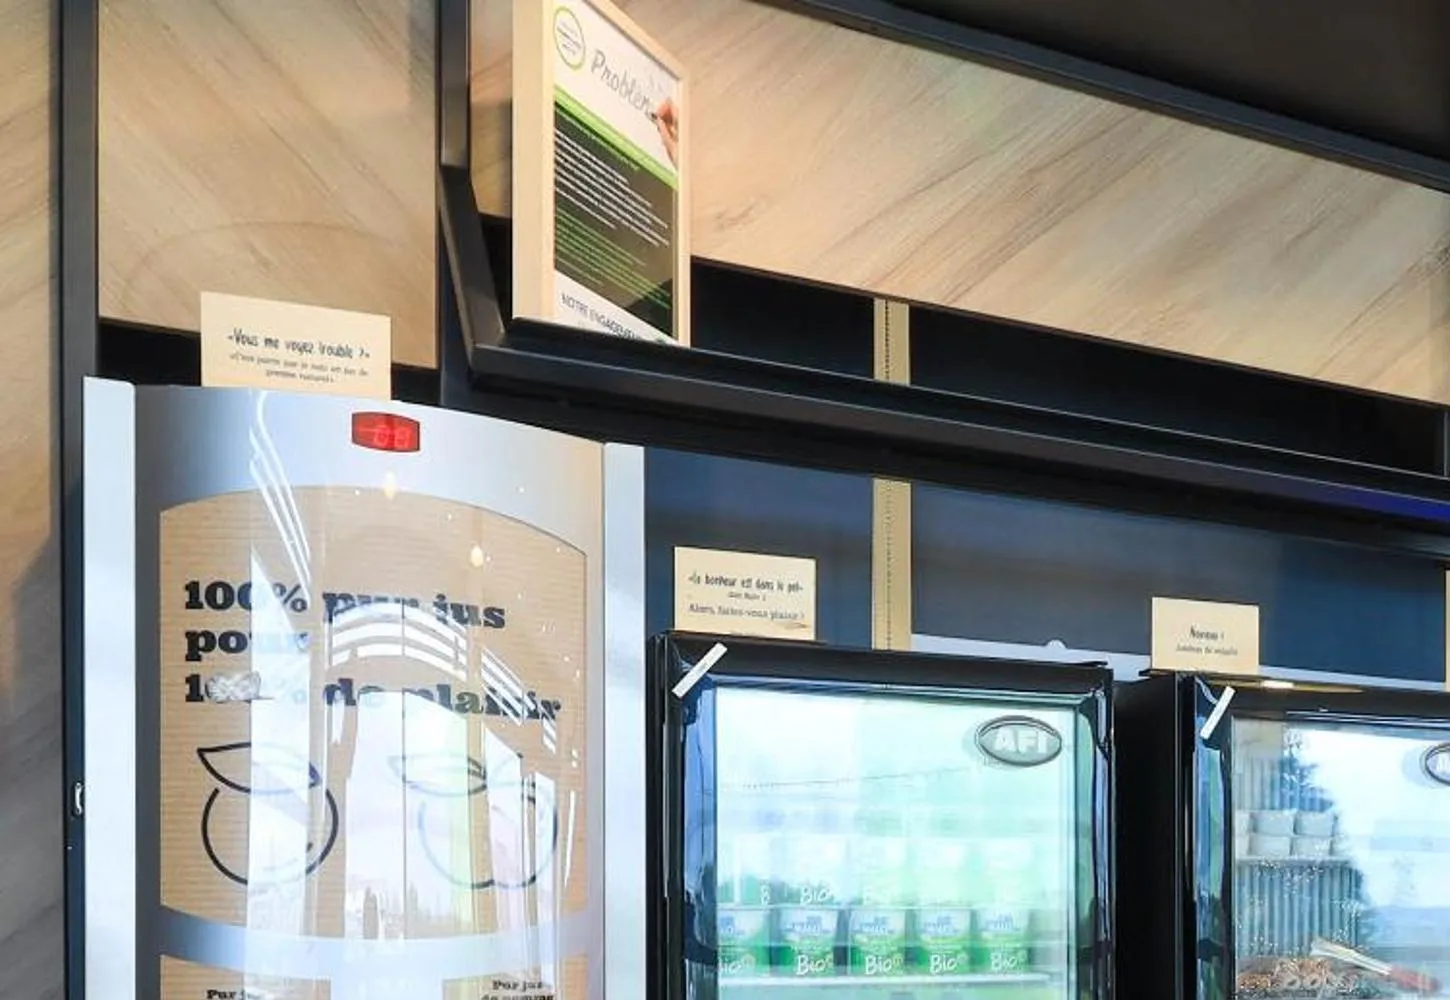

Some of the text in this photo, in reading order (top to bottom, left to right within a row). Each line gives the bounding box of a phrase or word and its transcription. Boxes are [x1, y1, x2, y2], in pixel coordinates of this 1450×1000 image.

[264, 337, 280, 349] me
[432, 591, 506, 629] jus
[796, 954, 825, 975] Bio
[865, 954, 893, 975] Bio
[929, 954, 957, 975] Bio
[206, 988, 237, 1000] Pur
